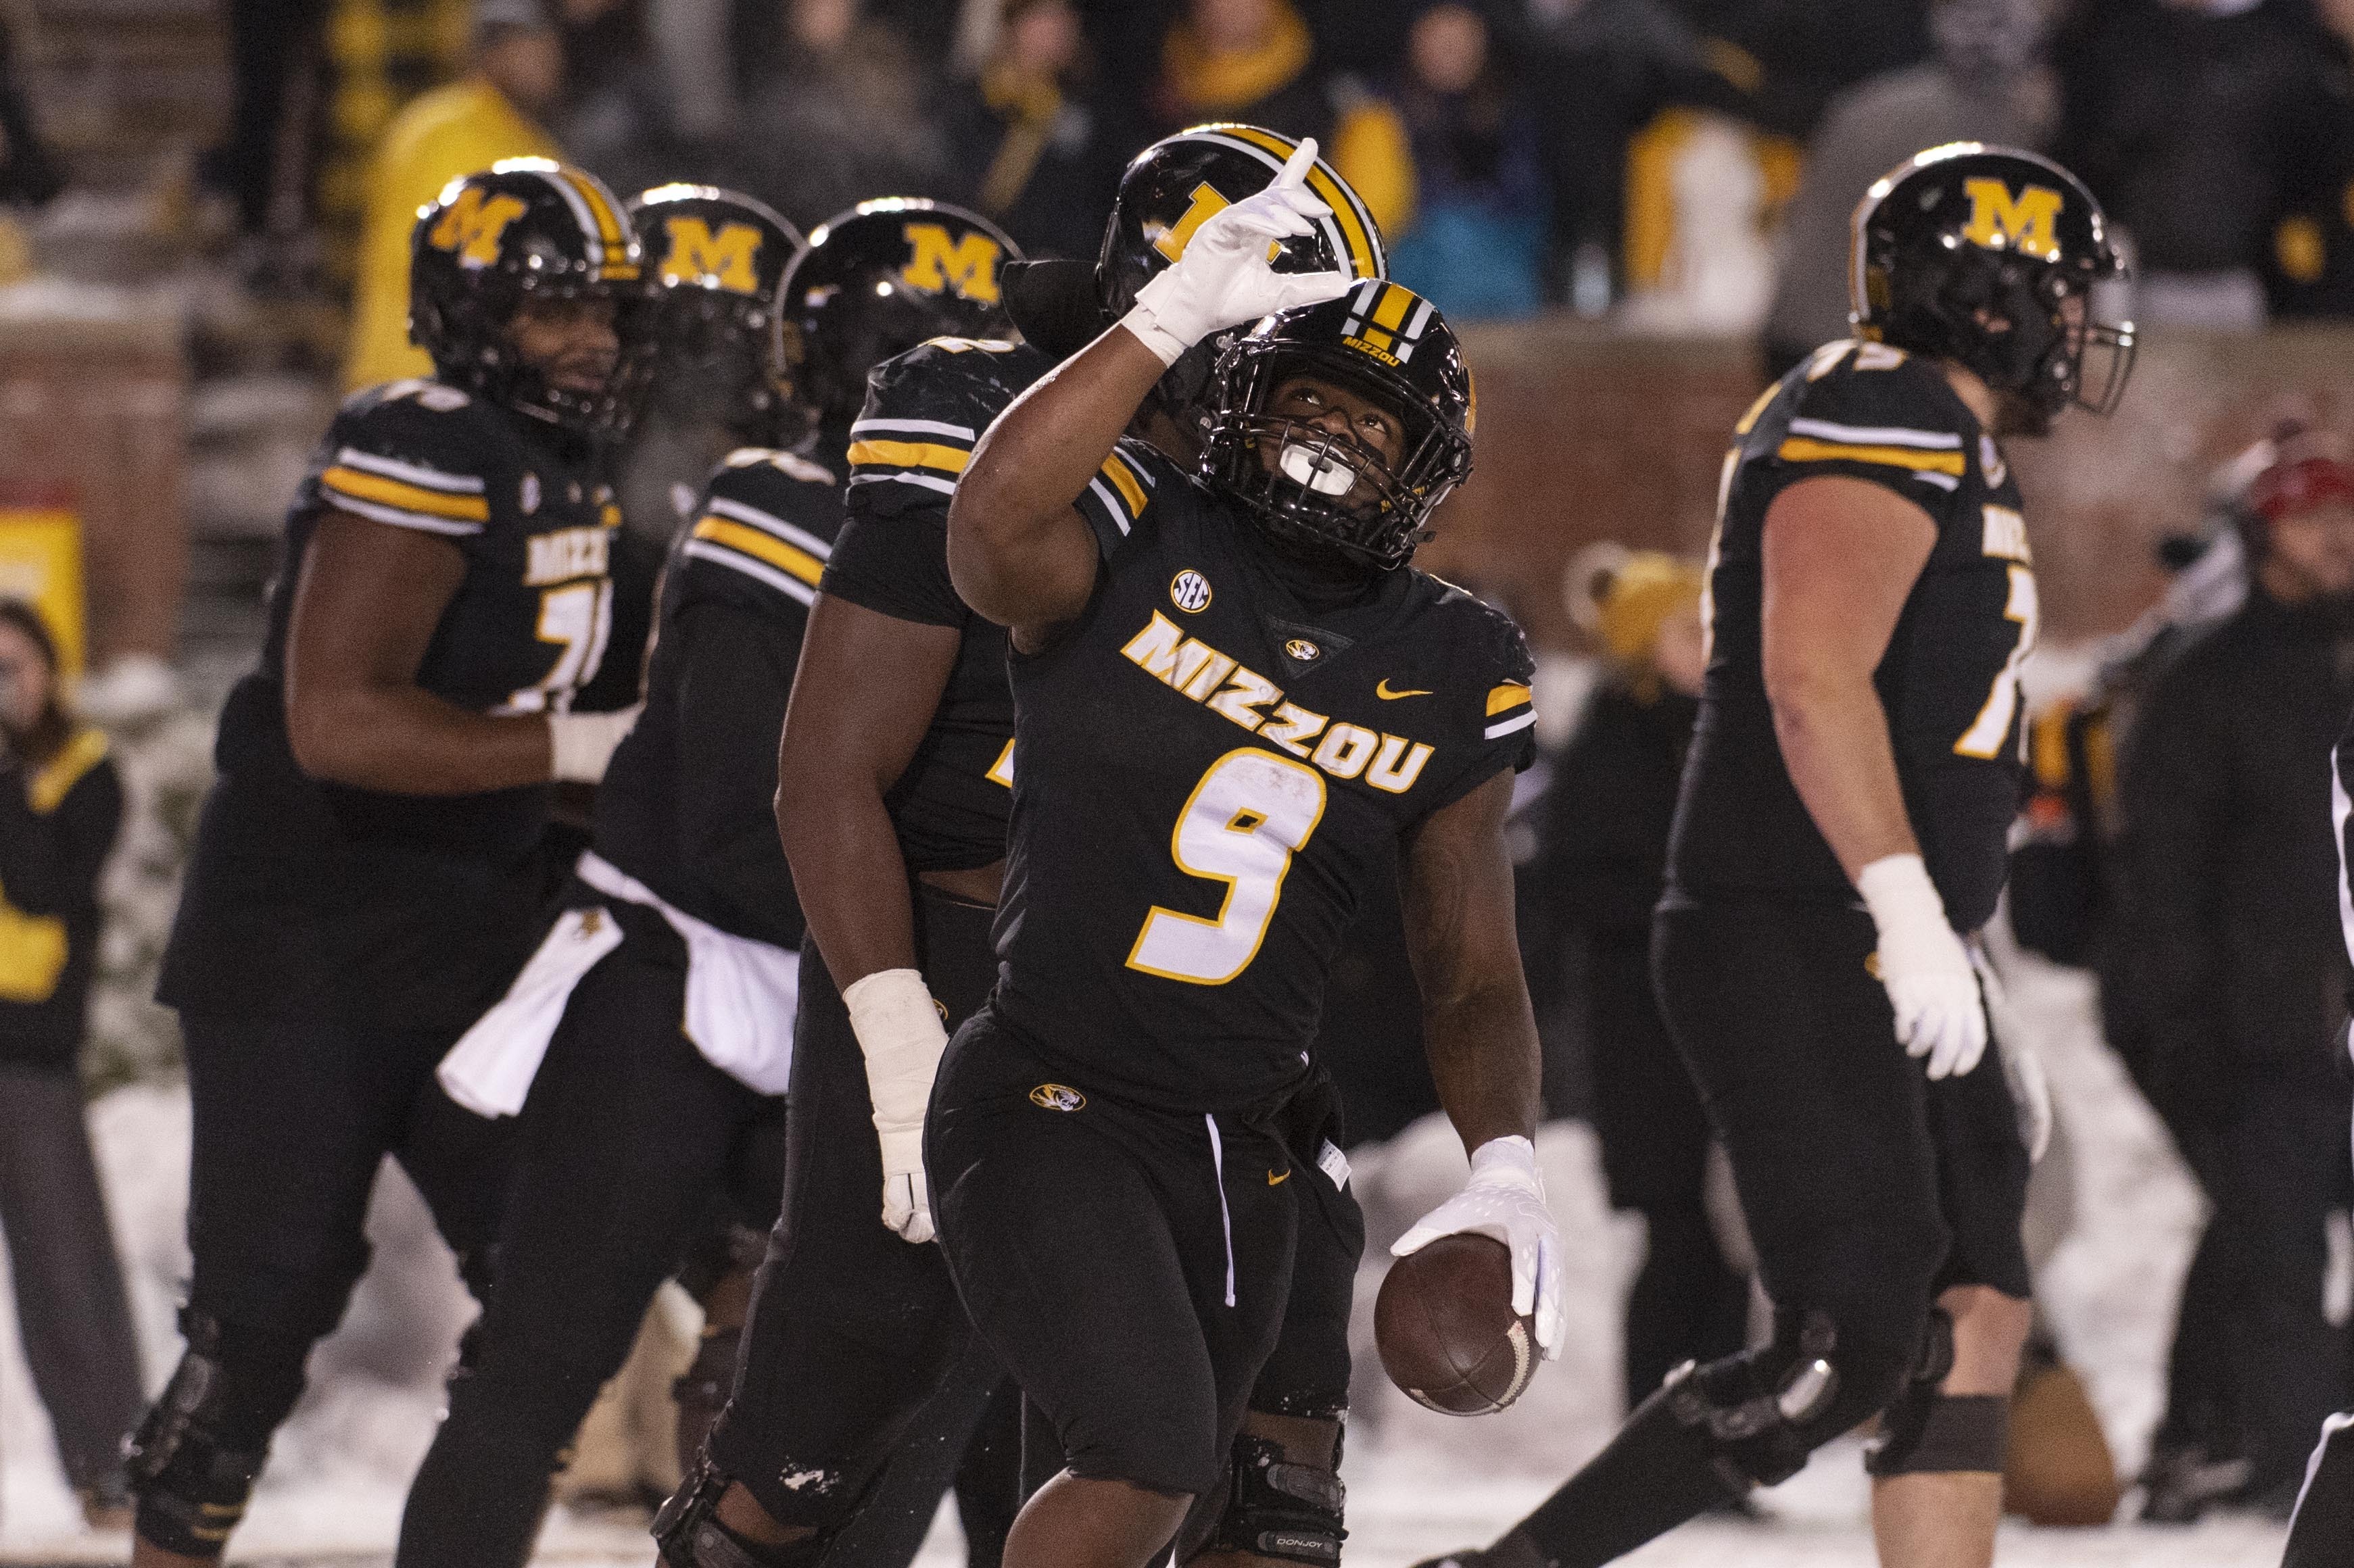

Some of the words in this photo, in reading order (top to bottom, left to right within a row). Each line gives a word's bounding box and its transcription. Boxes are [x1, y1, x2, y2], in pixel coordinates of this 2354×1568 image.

[430, 187, 529, 269] M
[660, 216, 763, 295] M
[1963, 177, 2064, 262] M
[902, 222, 1001, 303] M
[1342, 336, 1400, 366] MIZZOU
[1174, 572, 1209, 610] SEC
[1120, 608, 1435, 794] MIZZOU
[1124, 746, 1327, 986] 9
[1276, 1538, 1324, 1548] DONJOY
